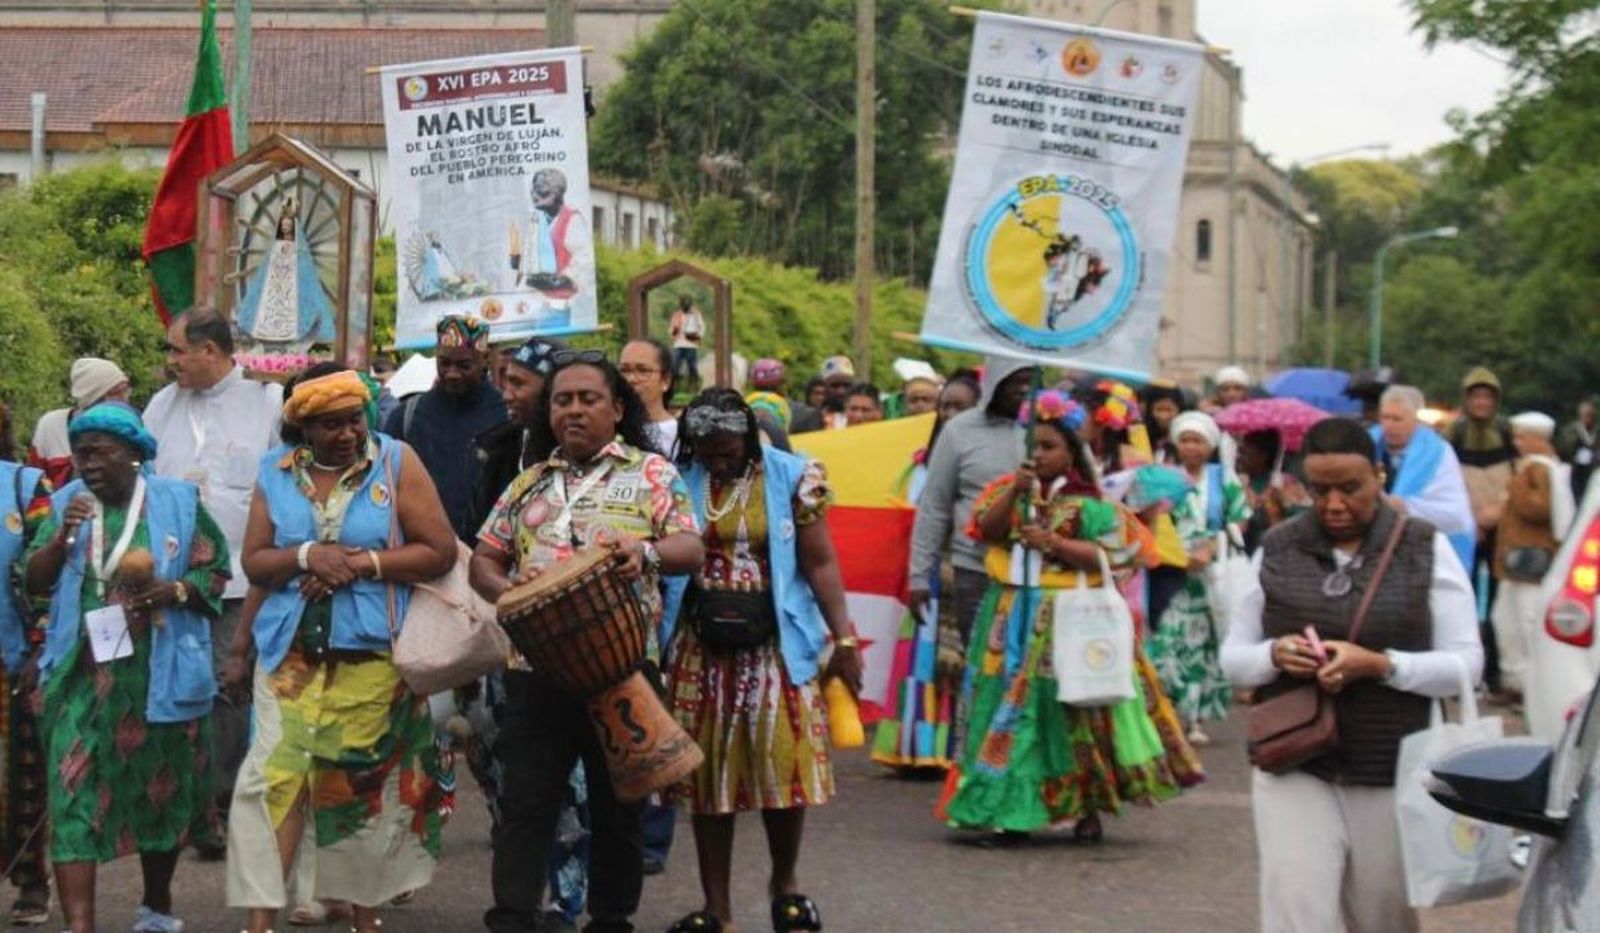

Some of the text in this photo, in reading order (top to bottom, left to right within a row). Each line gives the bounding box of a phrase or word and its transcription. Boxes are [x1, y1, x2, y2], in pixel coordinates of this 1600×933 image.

[437, 66, 550, 92] XVI EPA 2025
[976, 74, 1186, 118] LOS AFRODESCENDIENTES SUS
[417, 102, 545, 137] MANUEL
[972, 92, 1182, 135] CLAMORES Y SUS ESPERANZAS
[405, 142, 422, 154] DE
[426, 139, 443, 151] LA
[446, 133, 492, 148] VIRGEN
[496, 130, 512, 141] DE
[991, 112, 1159, 149] DENTRO DE UNA IGLESIA
[410, 151, 567, 178] DEL PUEBLO PEREGRINO
[429, 141, 540, 163] EL ROSTRO AFRO
[447, 174, 464, 185] EN
[1017, 174, 1121, 214] EPA 2025
[607, 487, 633, 501] 30
